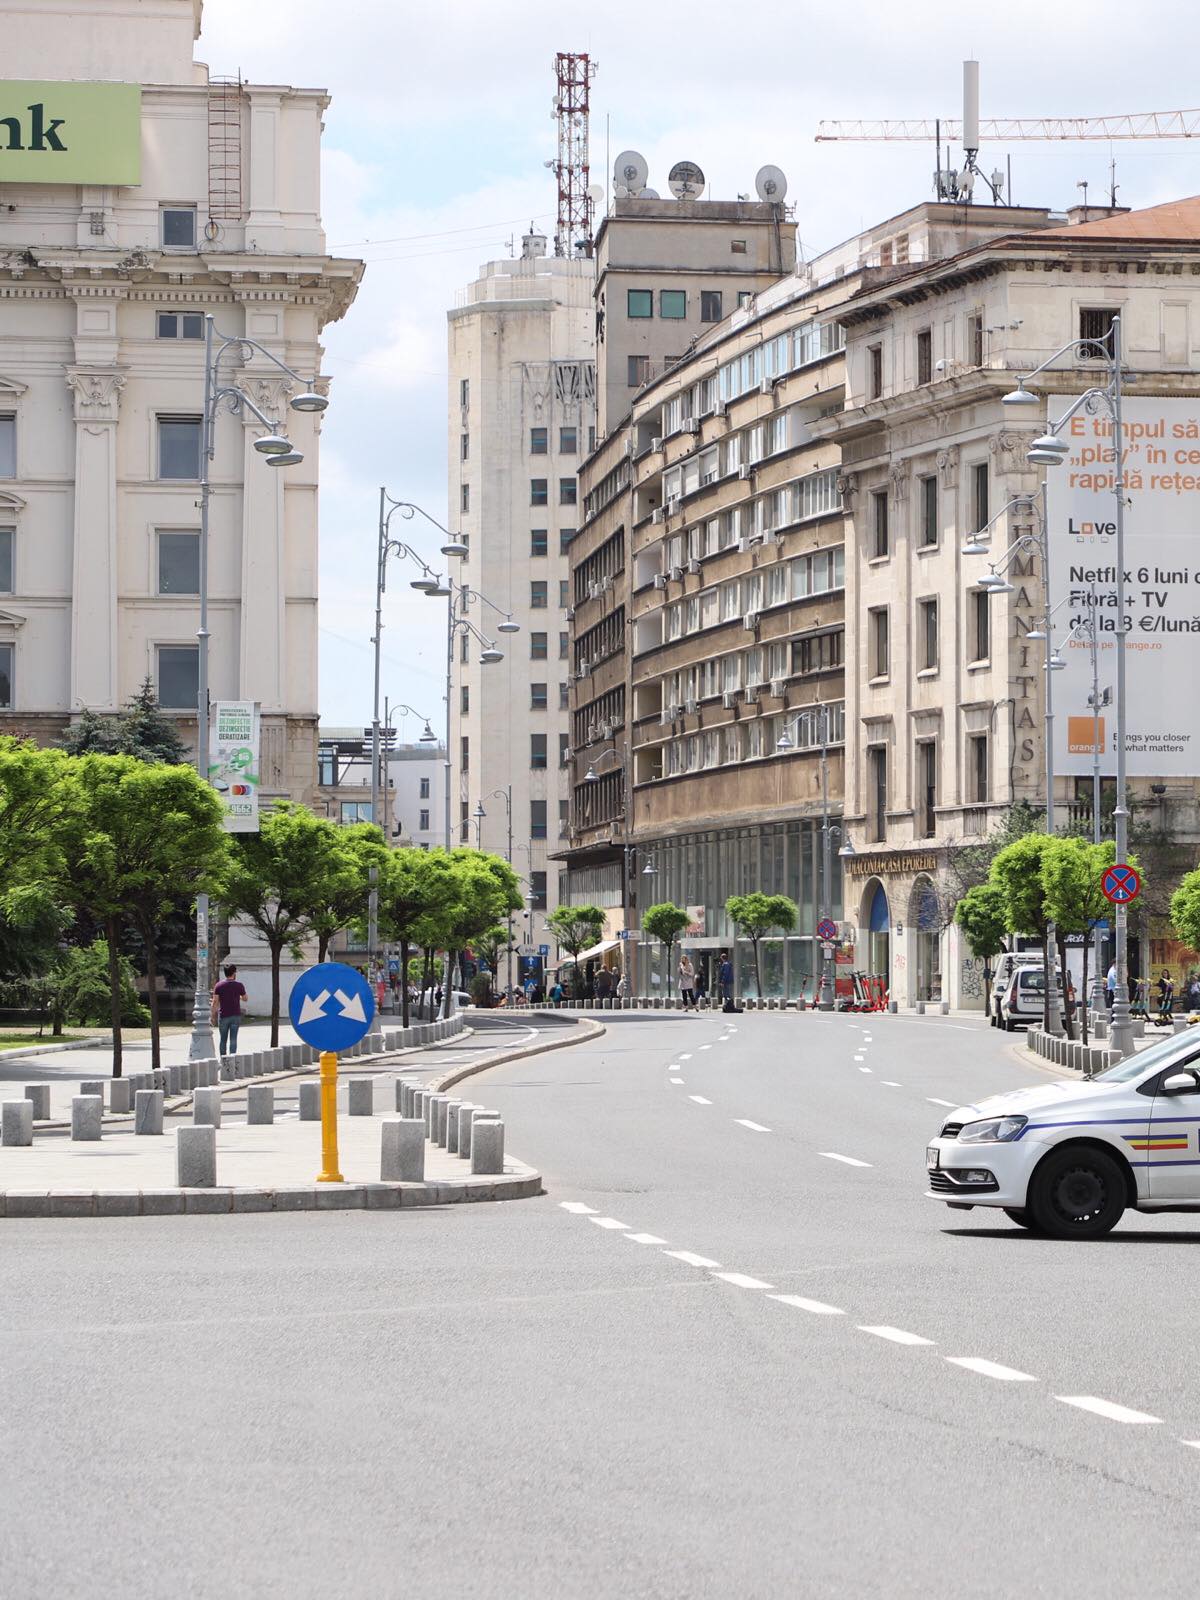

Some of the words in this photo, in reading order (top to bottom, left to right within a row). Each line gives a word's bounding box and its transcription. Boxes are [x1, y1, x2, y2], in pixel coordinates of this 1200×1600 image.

[0, 103, 68, 151] nk
[1070, 416, 1085, 436] E
[1092, 417, 1165, 441] timpul
[1172, 418, 1199, 439] să
[1146, 443, 1167, 464] în
[1069, 469, 1143, 493] rapidă
[1069, 566, 1132, 583] Netflx
[1137, 567, 1149, 584] 6
[1154, 568, 1188, 584] luni
[1069, 590, 1118, 607] Fibră
[1141, 591, 1169, 608] TV
[1099, 615, 1115, 632] la
[1117, 641, 1162, 651] ange.ro
[1113, 732, 1142, 743] Bngs
[1144, 735, 1161, 743] you
[1162, 733, 1191, 742] closer
[1125, 744, 1147, 752] what
[1148, 744, 1185, 753] matters
